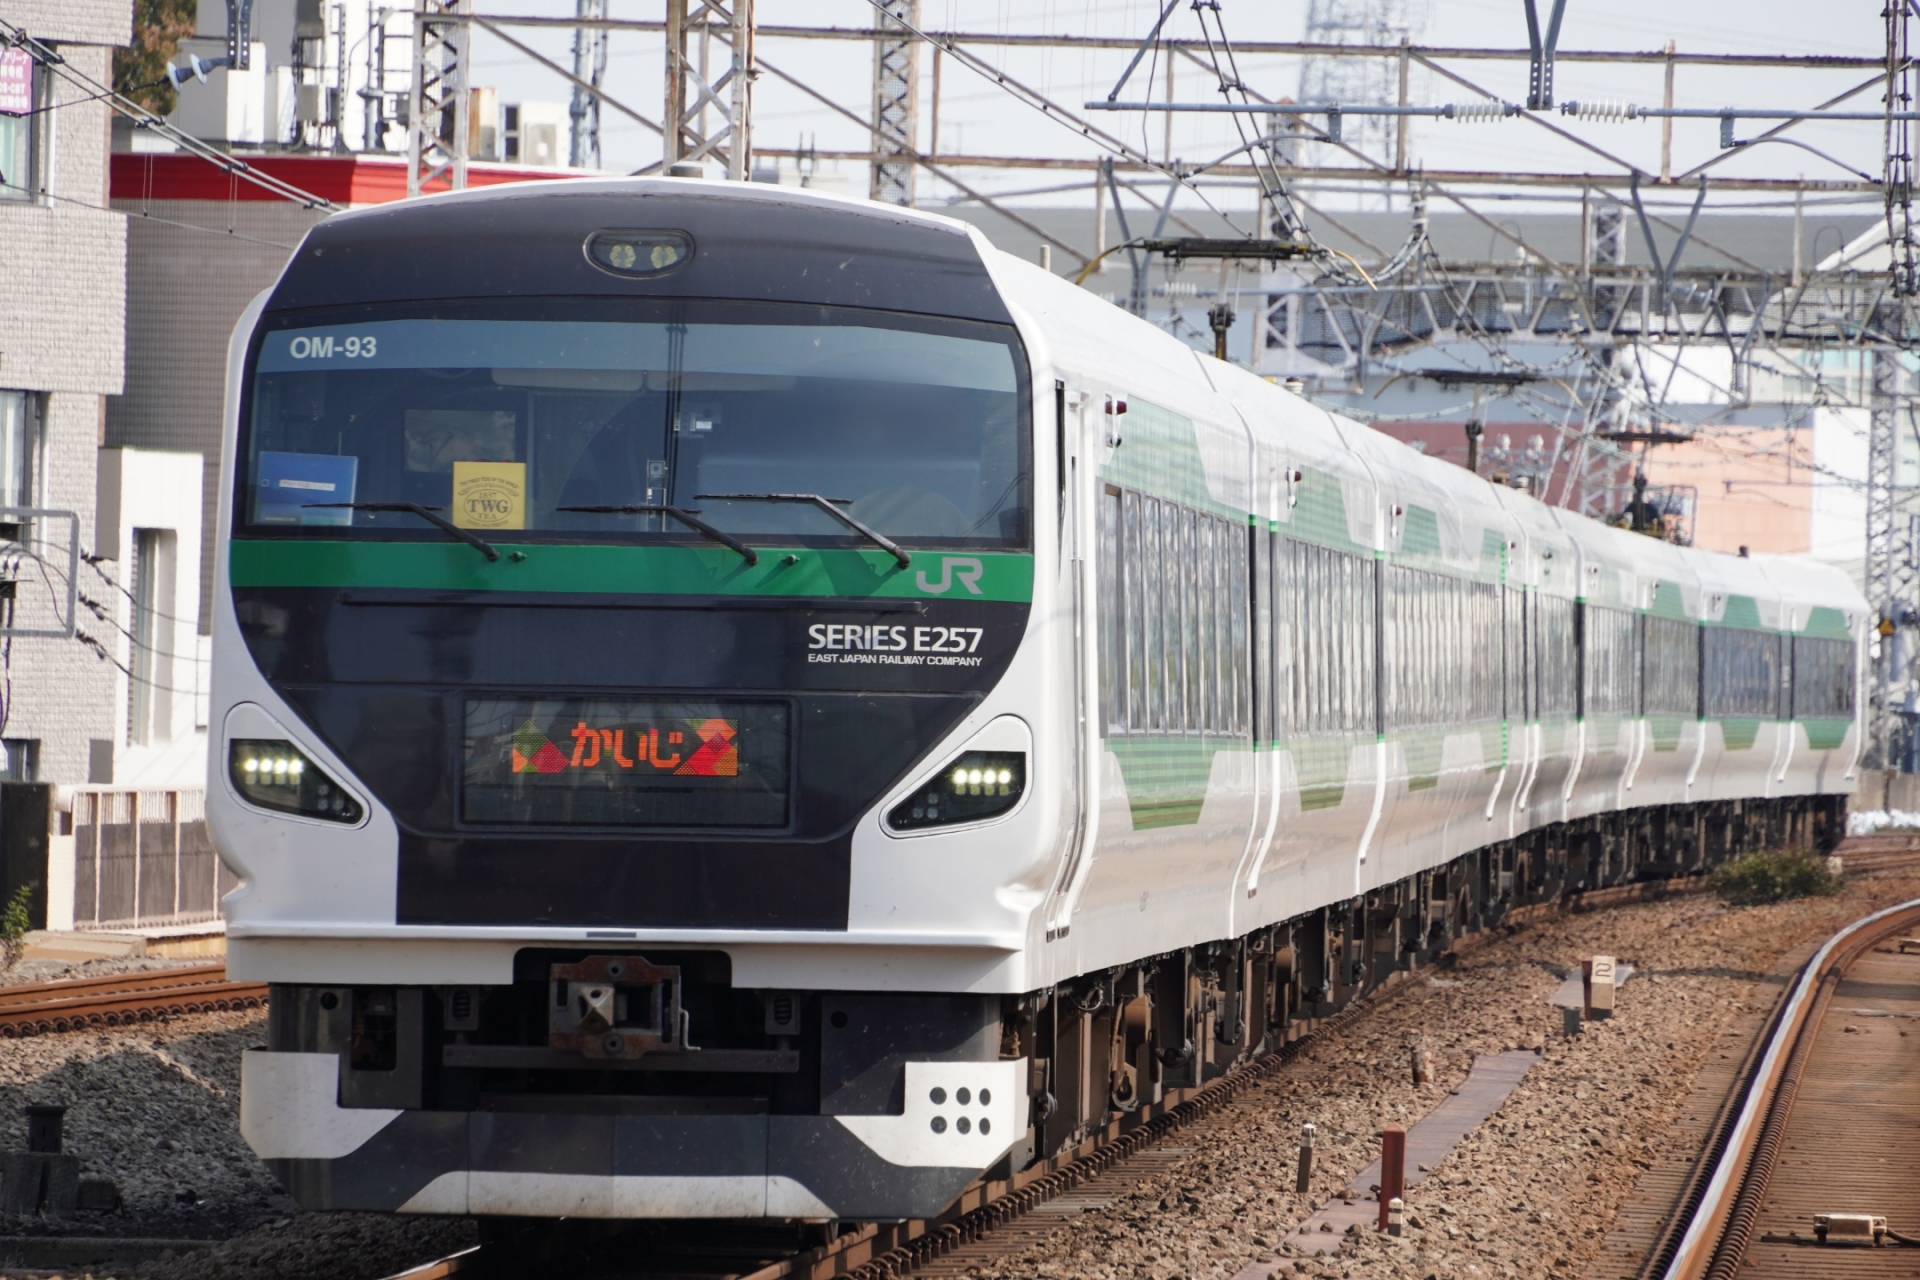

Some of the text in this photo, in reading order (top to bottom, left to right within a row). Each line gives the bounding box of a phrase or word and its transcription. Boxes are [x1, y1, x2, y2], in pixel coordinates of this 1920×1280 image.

[289, 336, 377, 359] OM-93
[467, 499, 509, 513] TWG
[916, 556, 984, 595] JR
[808, 623, 984, 653] SERIES E257
[808, 653, 983, 667] EAST JAPAN RAILWAY COMPANY
[570, 721, 683, 767] かいじ
[1596, 963, 1611, 977] 2
